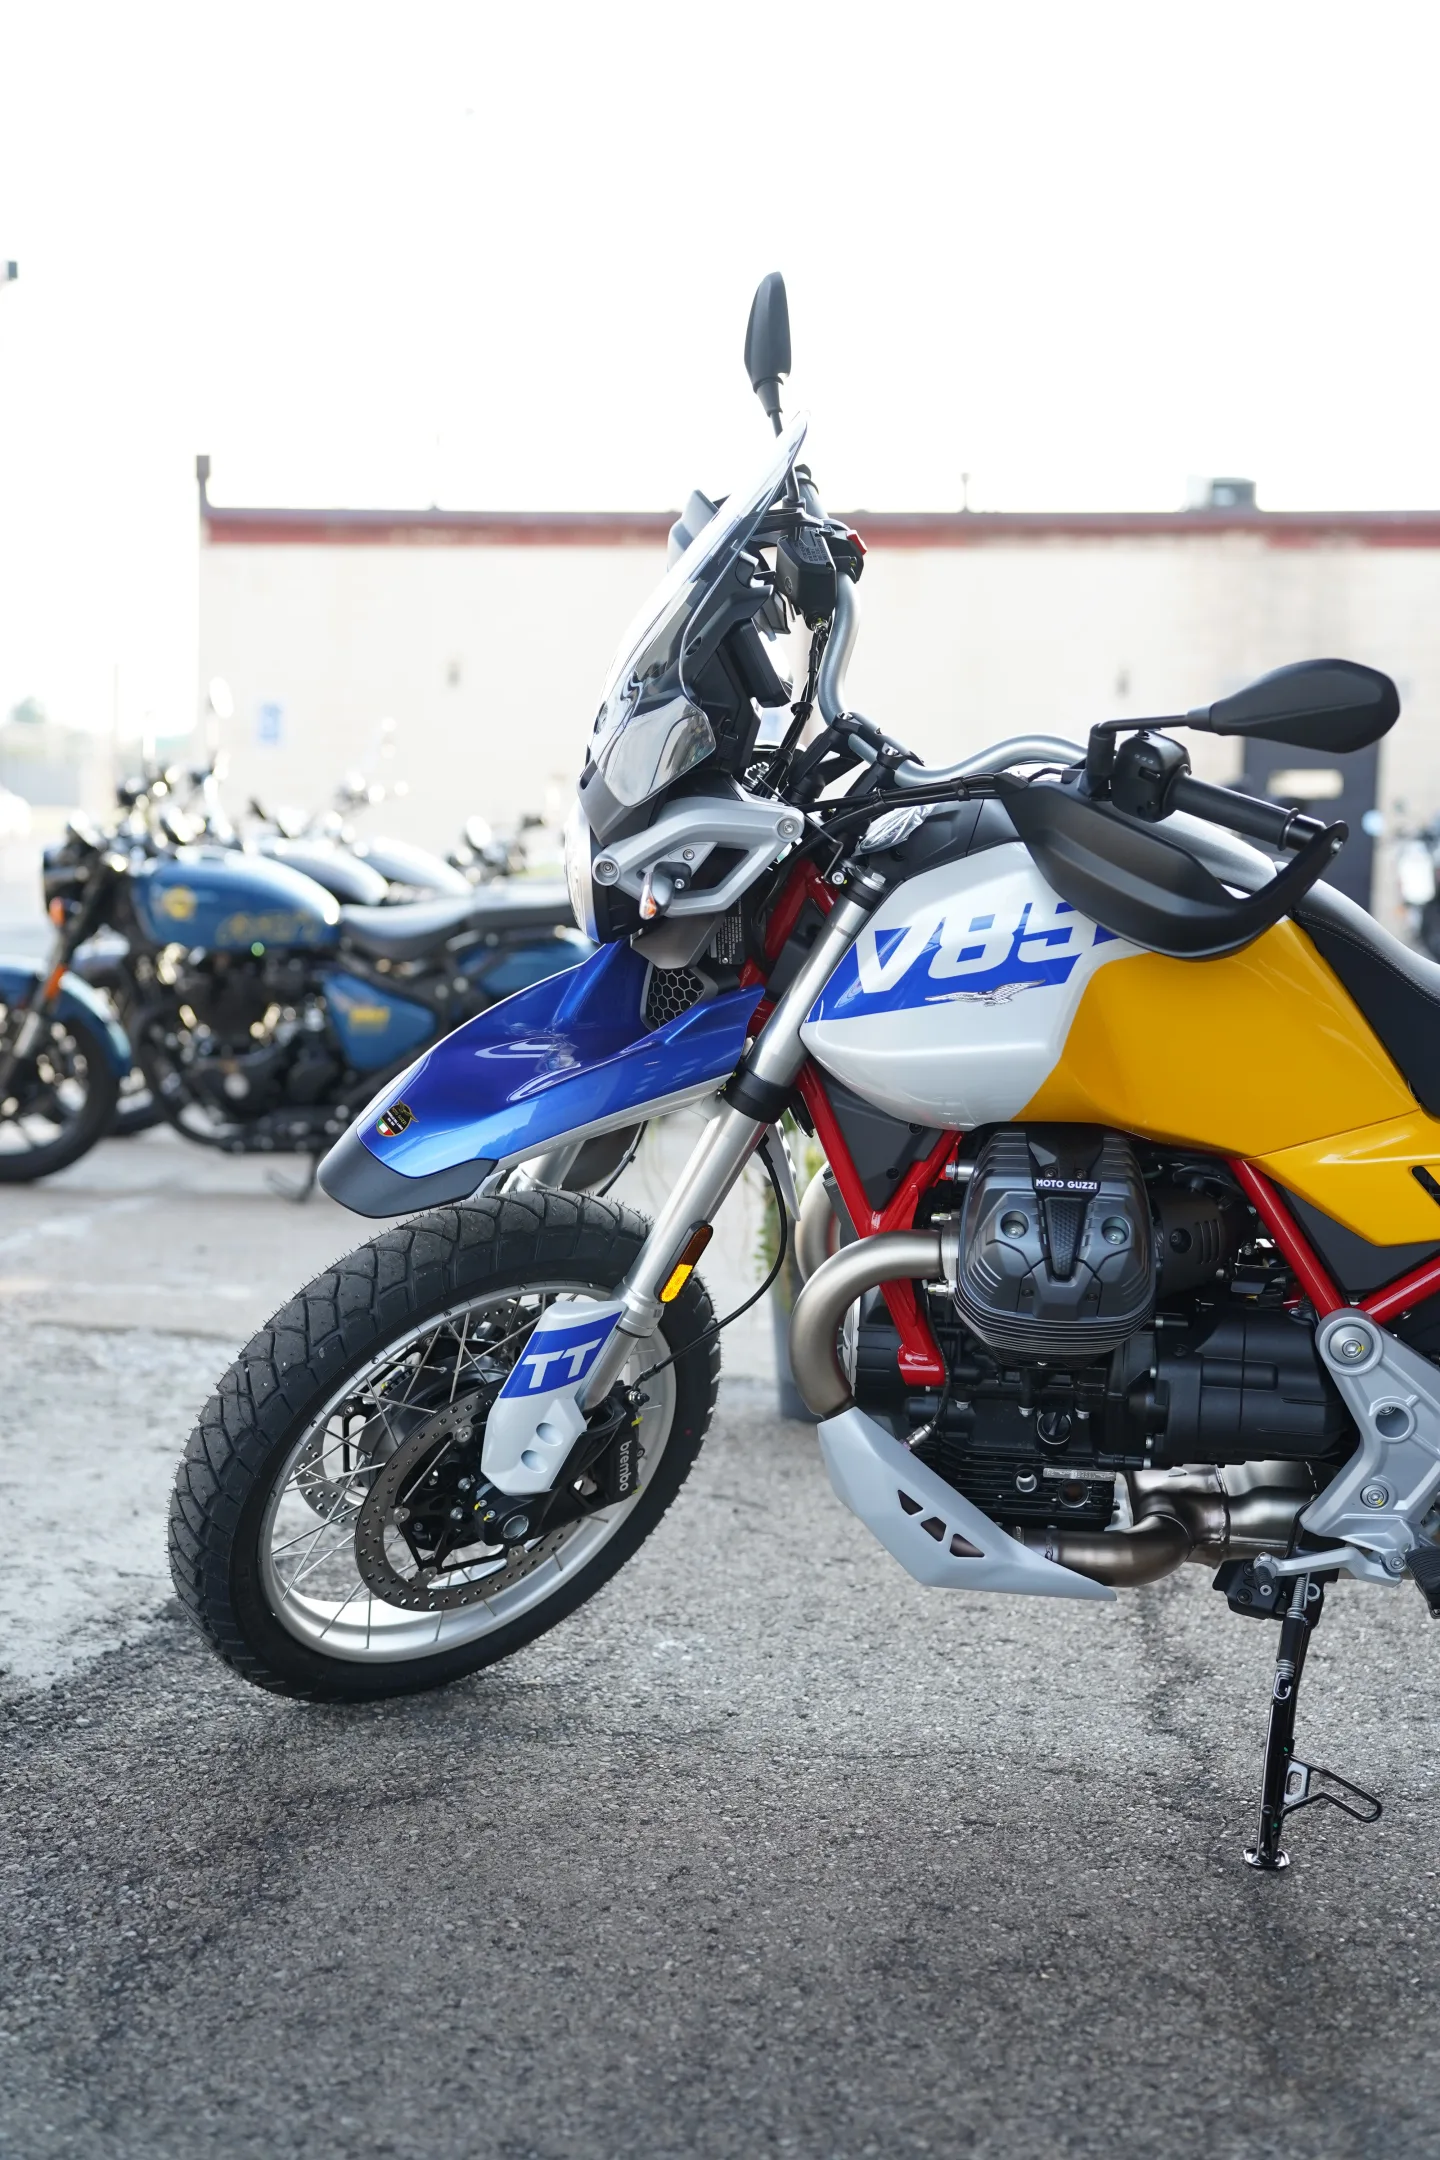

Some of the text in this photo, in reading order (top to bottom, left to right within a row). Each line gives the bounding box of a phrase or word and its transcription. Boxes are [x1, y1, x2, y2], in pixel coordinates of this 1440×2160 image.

[854, 897, 1098, 994] V85
[1035, 1178, 1097, 1190] MOTO GUZZI
[521, 1337, 602, 1389] TT
[619, 1439, 632, 1492] brembo
